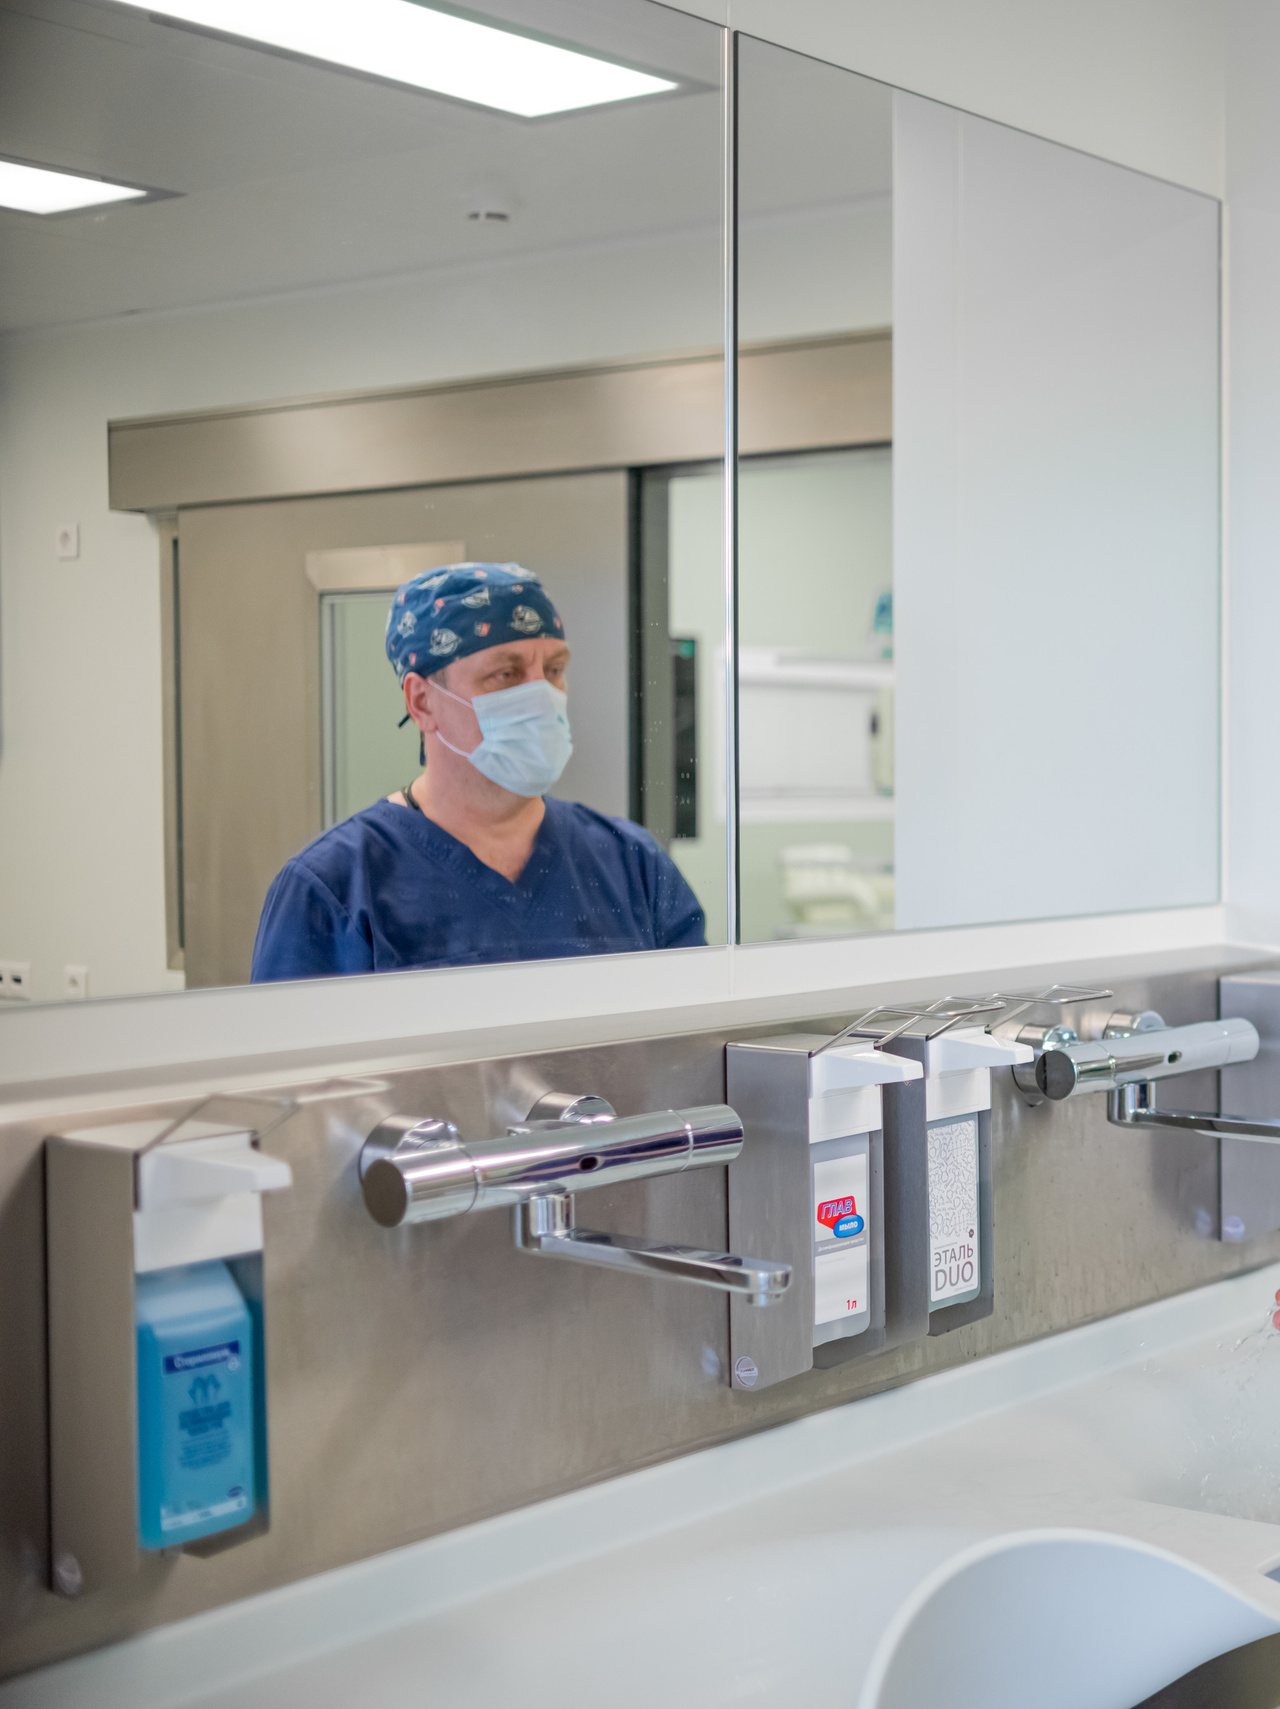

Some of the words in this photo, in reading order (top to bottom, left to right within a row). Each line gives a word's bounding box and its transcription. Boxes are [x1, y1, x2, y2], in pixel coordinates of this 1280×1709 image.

[821, 1199, 853, 1219] ГЛАВ
[934, 1243, 974, 1268] ЭТАЛЬ
[935, 1260, 974, 1292] DUO
